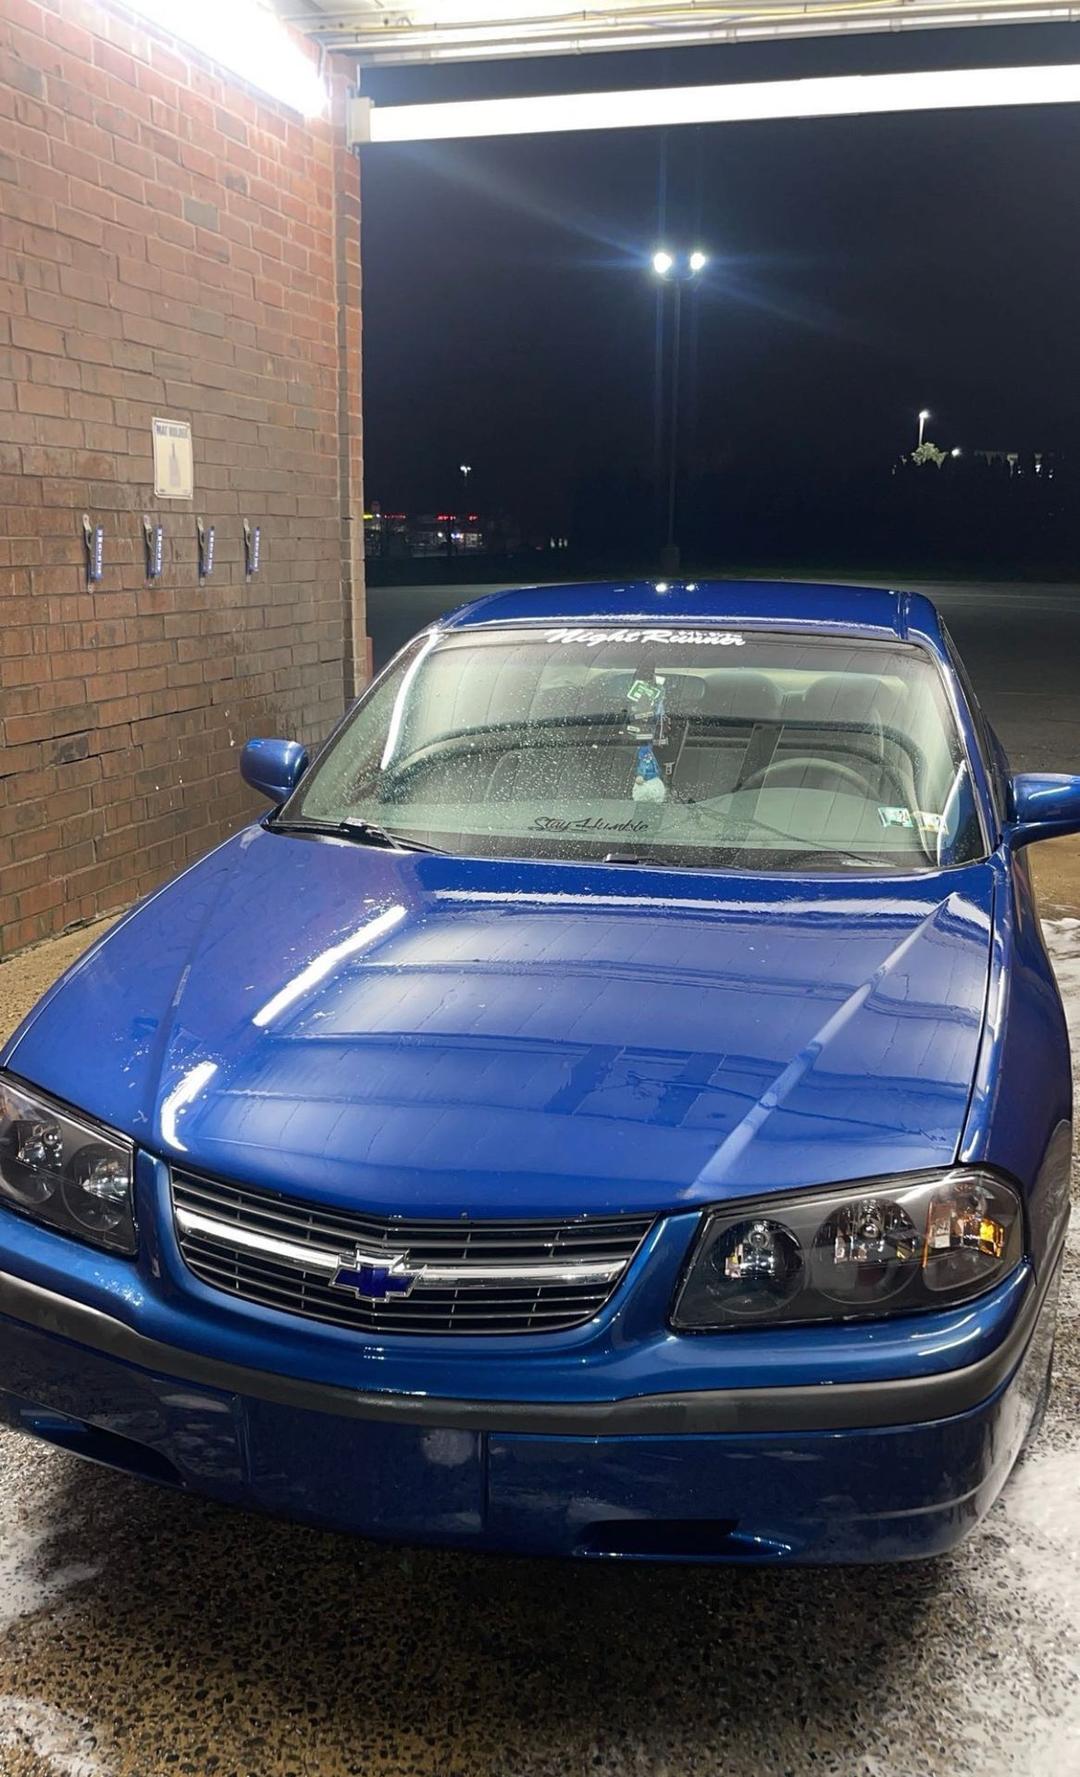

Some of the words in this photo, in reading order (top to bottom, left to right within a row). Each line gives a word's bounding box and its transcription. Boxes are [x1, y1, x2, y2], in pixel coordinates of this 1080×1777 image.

[544, 628, 639, 647] Night
[529, 816, 572, 832] Stay
[572, 817, 649, 832] Humble
